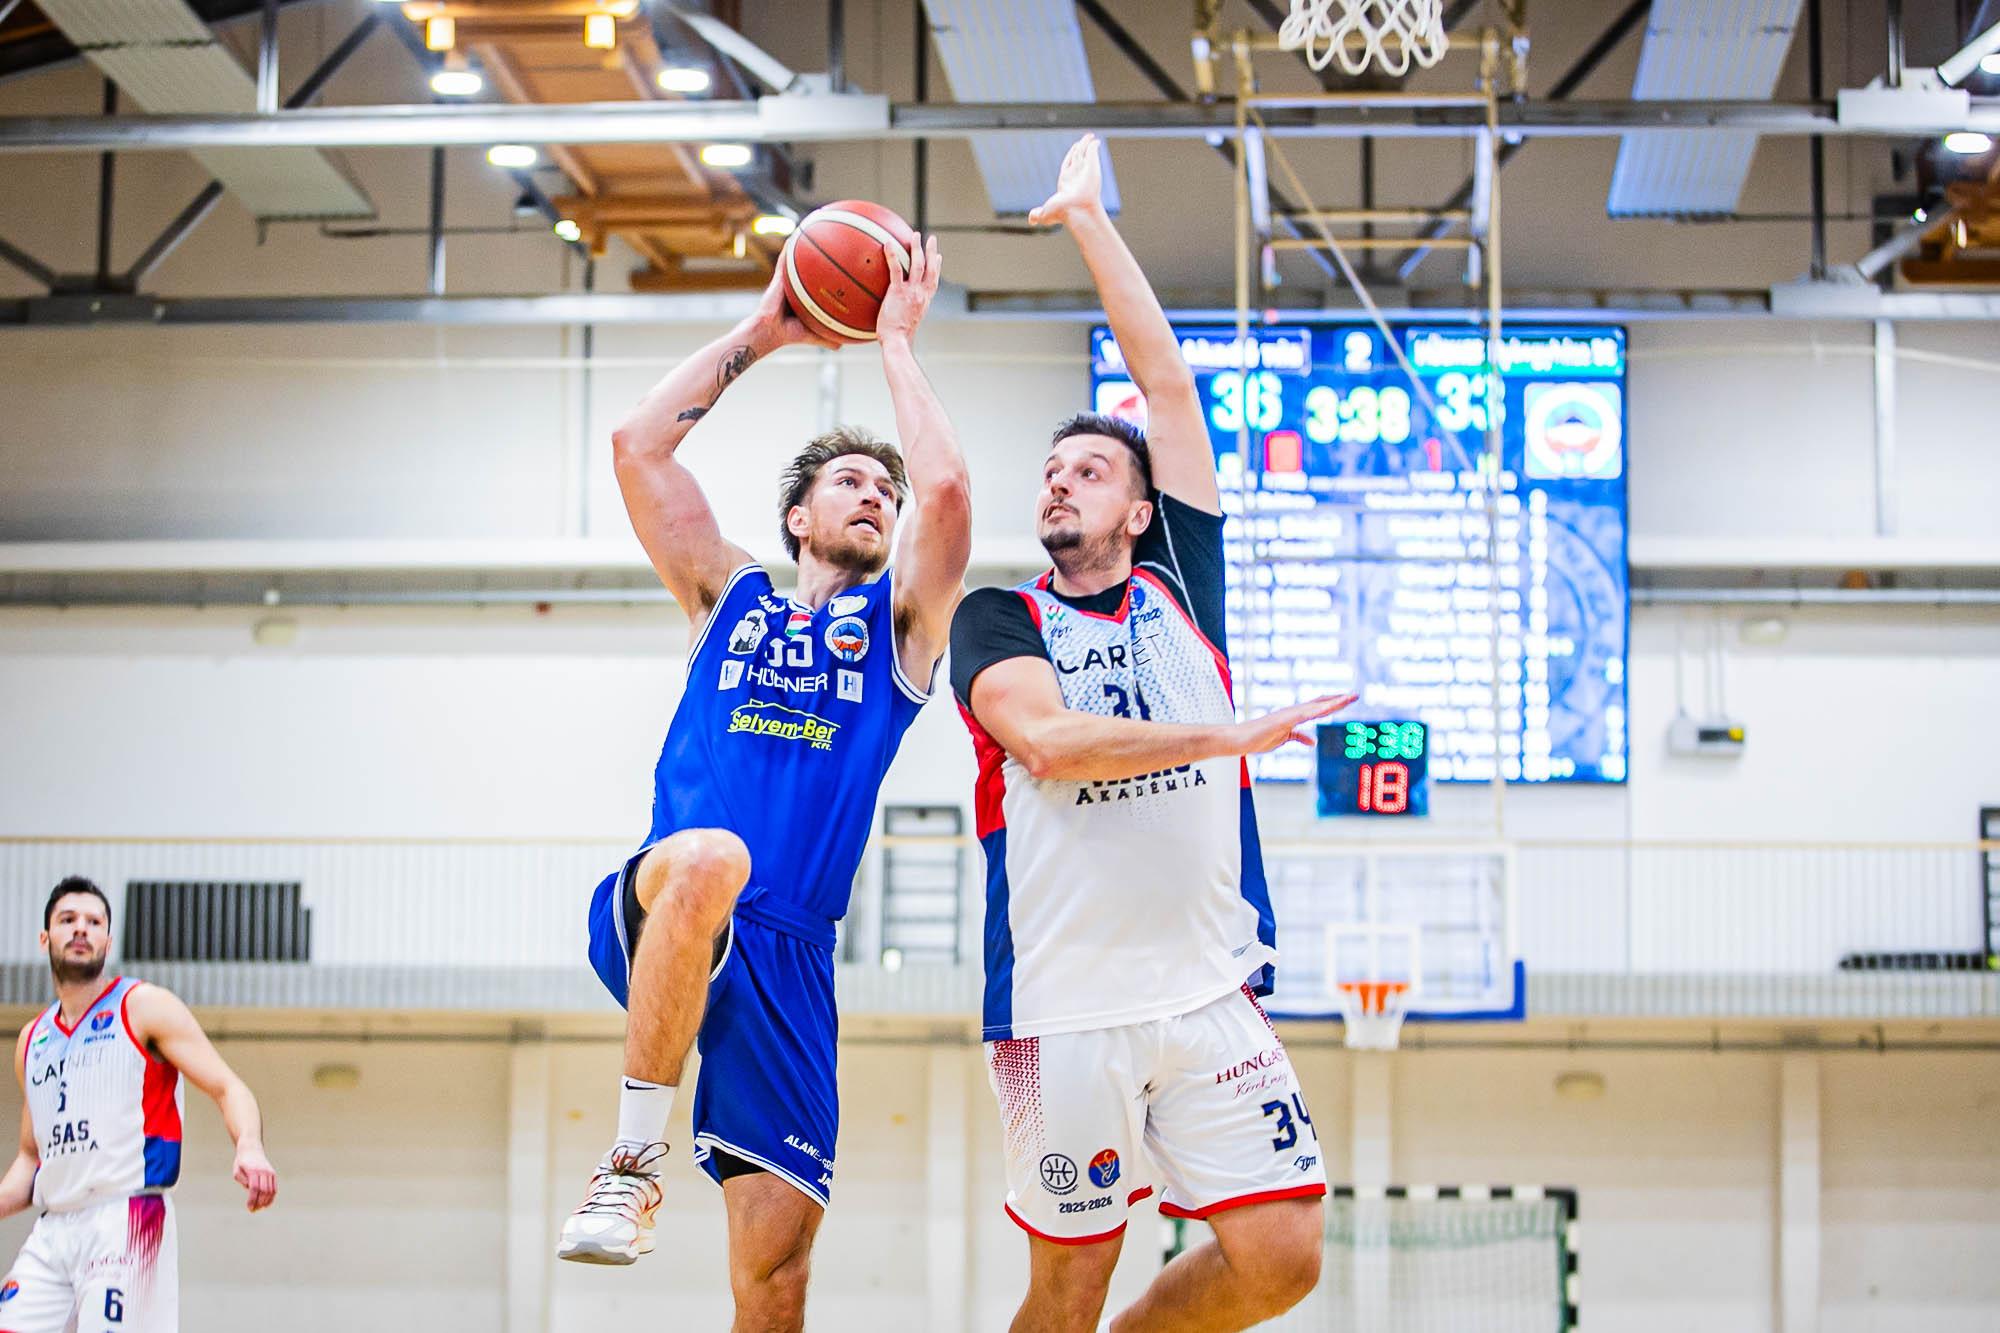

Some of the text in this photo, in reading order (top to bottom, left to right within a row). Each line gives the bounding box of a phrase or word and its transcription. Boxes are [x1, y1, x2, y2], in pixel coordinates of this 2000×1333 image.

[1344, 333, 1372, 371] 2
[1211, 371, 1283, 432] 36
[1305, 386, 1411, 444] 3:38
[730, 711, 836, 740] Selyem-Ber
[1344, 721, 1424, 760] 3:38
[811, 741, 832, 751] Kft.
[1358, 761, 1409, 813] 18
[1059, 1196, 1113, 1213] 2025-2026
[104, 1288, 124, 1322] 6
